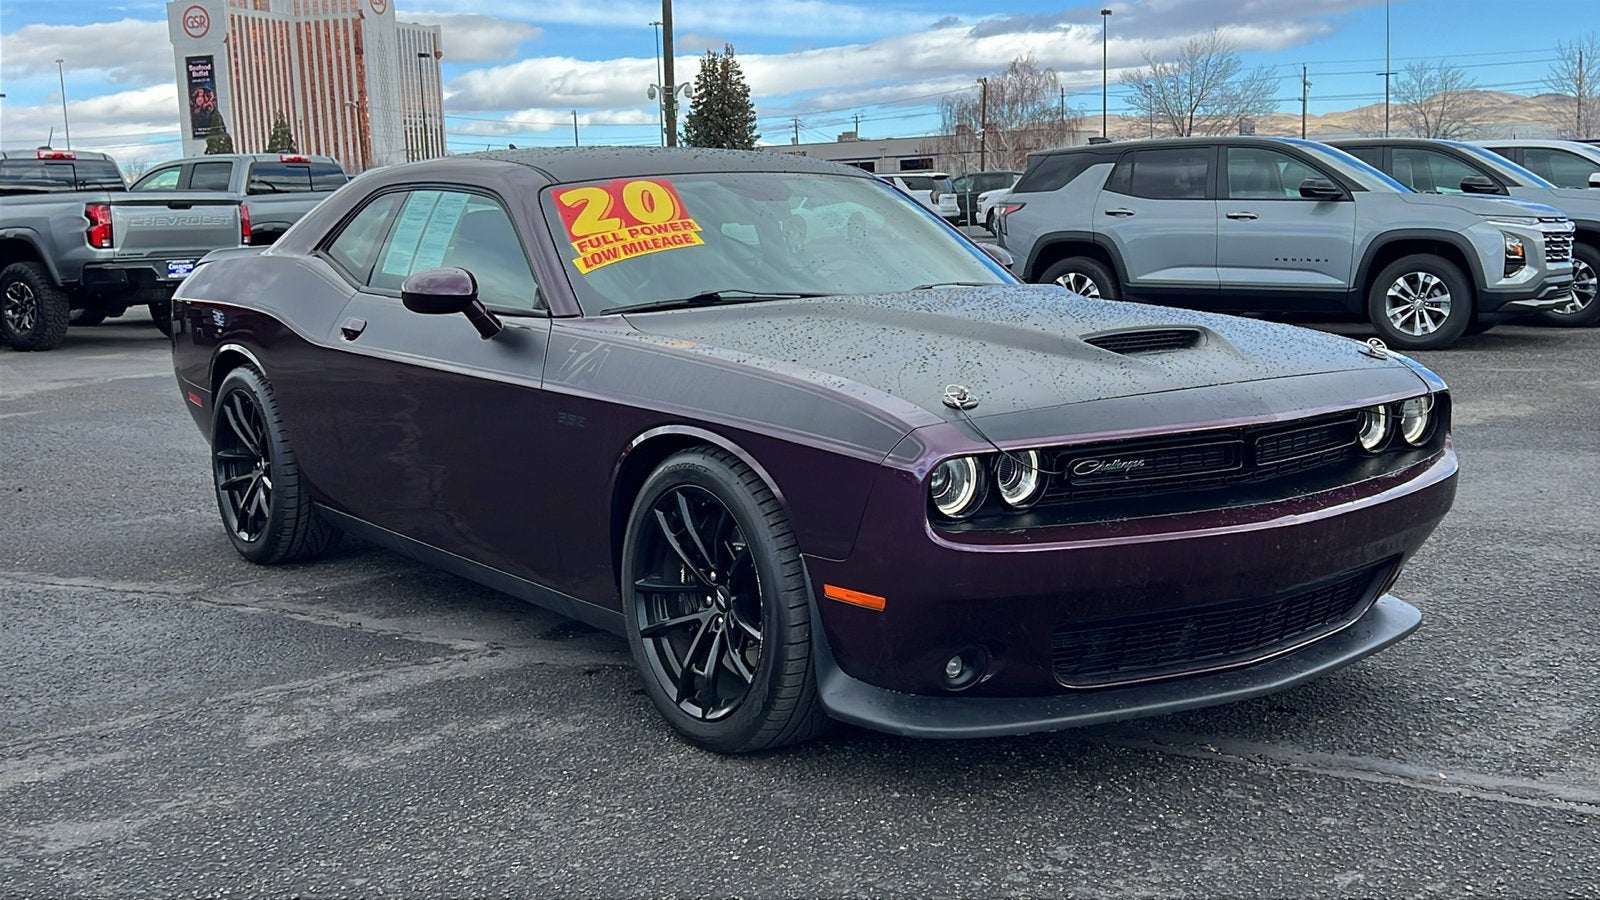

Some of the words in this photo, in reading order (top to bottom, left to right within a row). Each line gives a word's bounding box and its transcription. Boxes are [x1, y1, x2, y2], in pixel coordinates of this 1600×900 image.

[186, 14, 207, 29] GSR
[559, 180, 681, 237] 20
[129, 216, 234, 227] CHEVROLET
[576, 231, 627, 253] FULL
[628, 221, 695, 238] POWER
[582, 246, 621, 269] LOW
[621, 233, 695, 256] MILEAGE
[1073, 459, 1145, 475] Challenger
